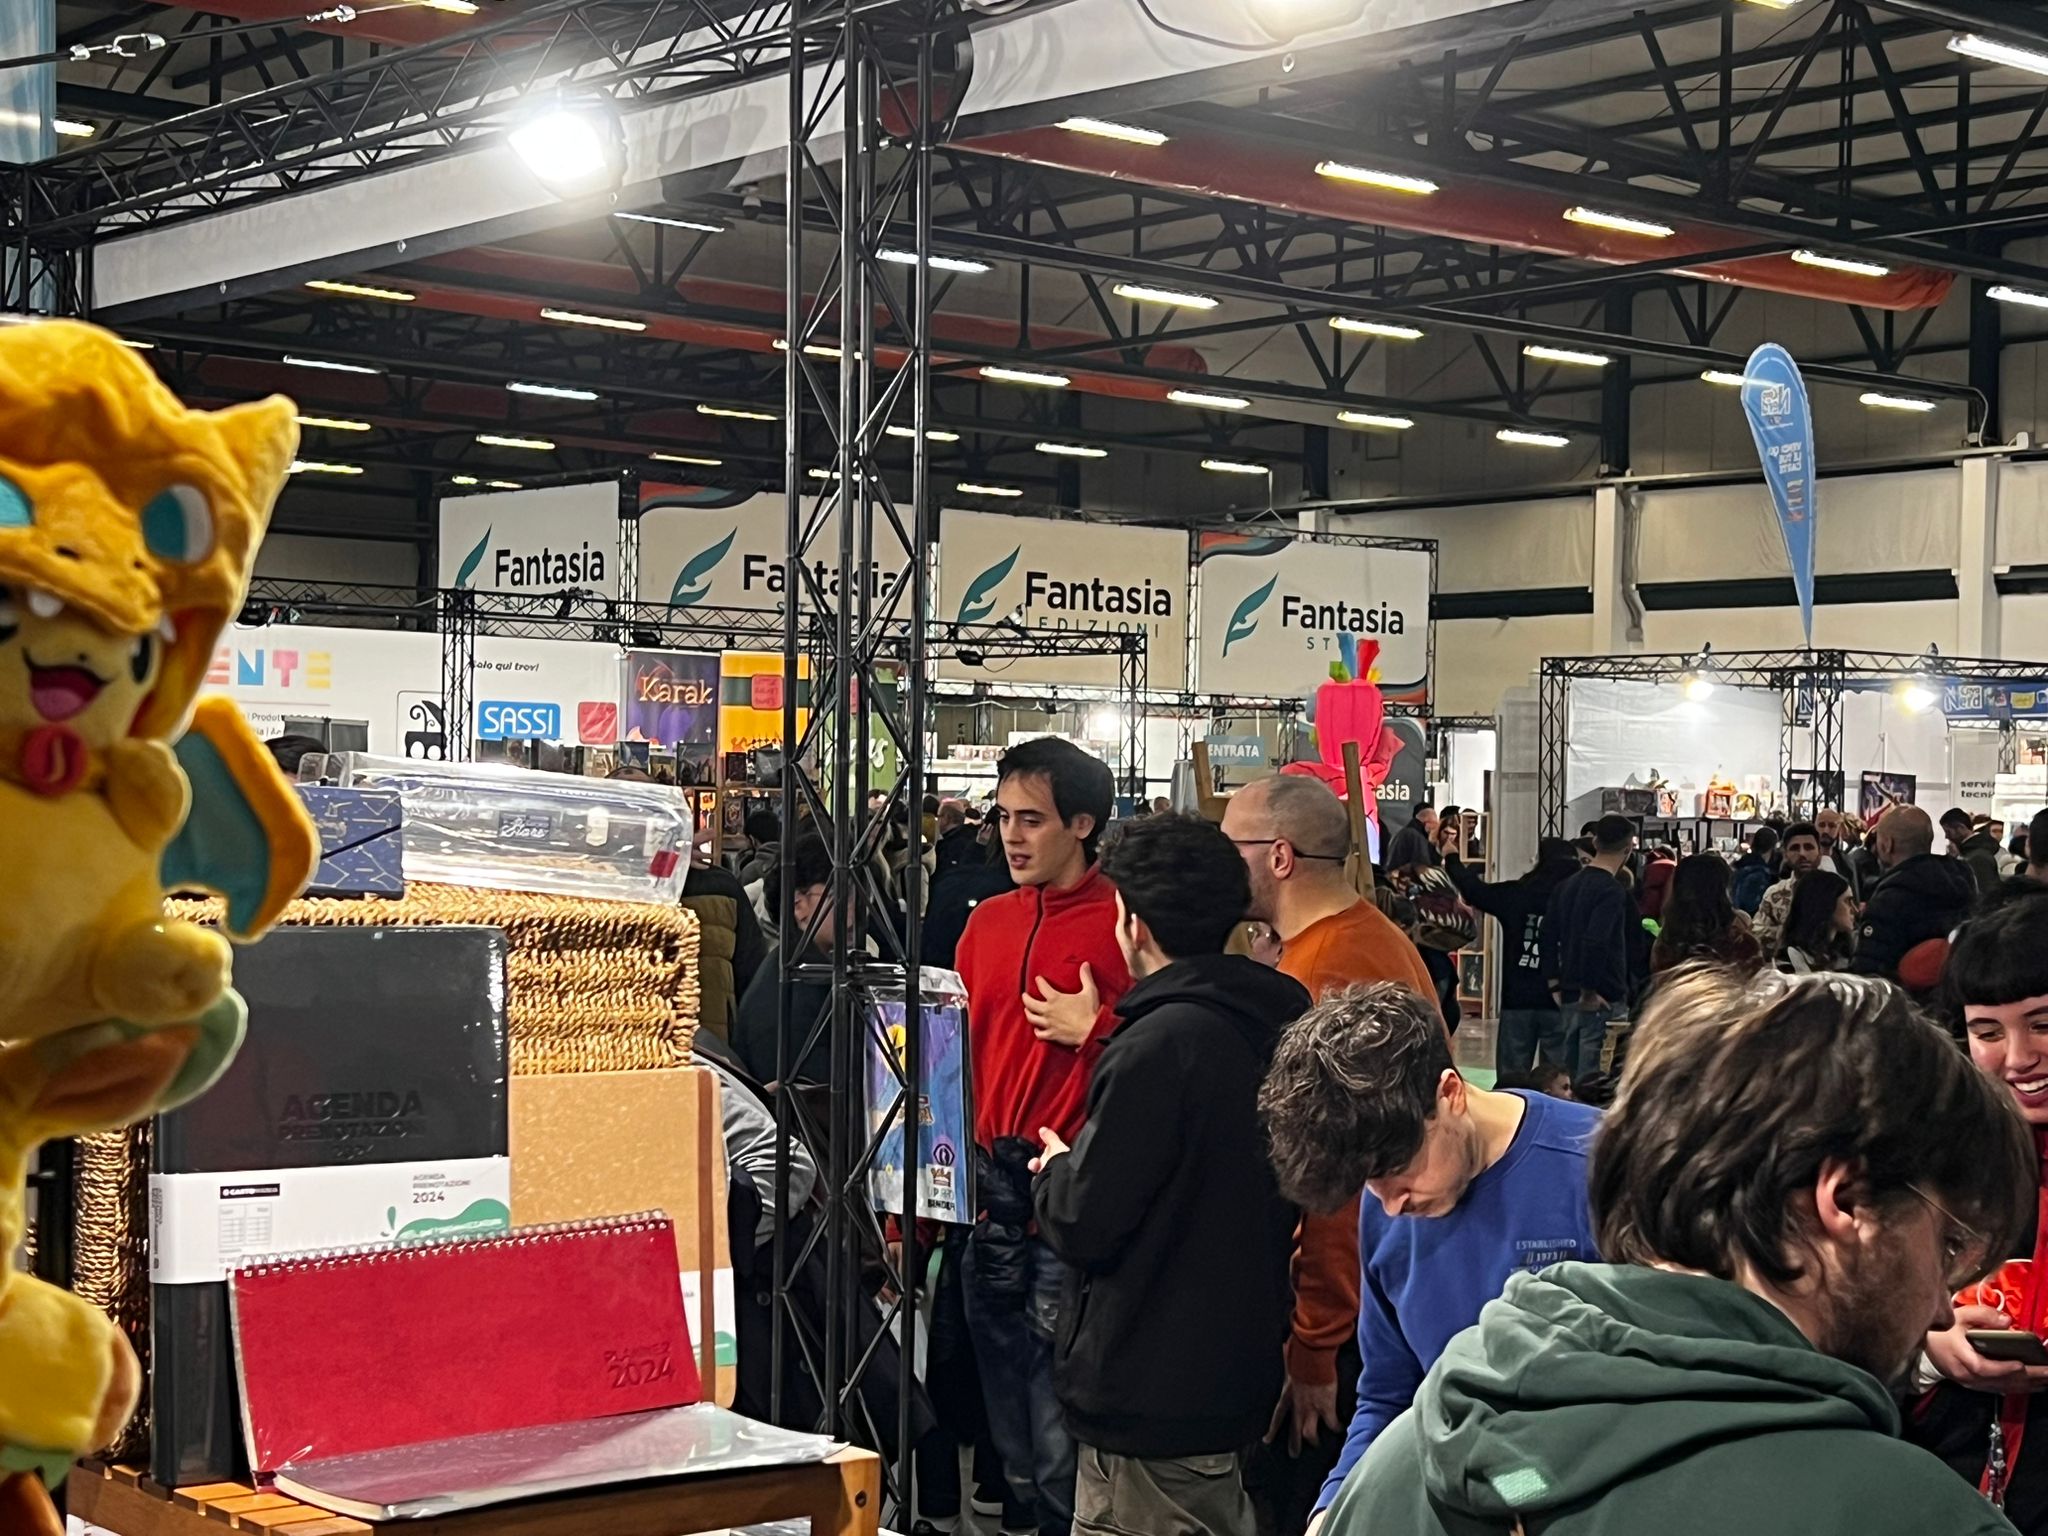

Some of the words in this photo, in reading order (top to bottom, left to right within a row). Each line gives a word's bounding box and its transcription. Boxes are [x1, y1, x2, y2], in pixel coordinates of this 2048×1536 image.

[495, 541, 605, 587] Fantasia
[1025, 571, 1171, 617] Fantasia
[1039, 616, 1159, 638] EDIZIONI
[1282, 595, 1404, 635] Fantasia
[207, 648, 331, 689] ENTE
[639, 676, 713, 704] Karak
[484, 707, 553, 735] SASSI
[1207, 743, 1260, 758] ENTRATA
[1374, 779, 1410, 800] asia
[1961, 790, 1995, 798] tecni
[412, 1191, 445, 1204] 2024
[607, 1357, 676, 1390] 2024
